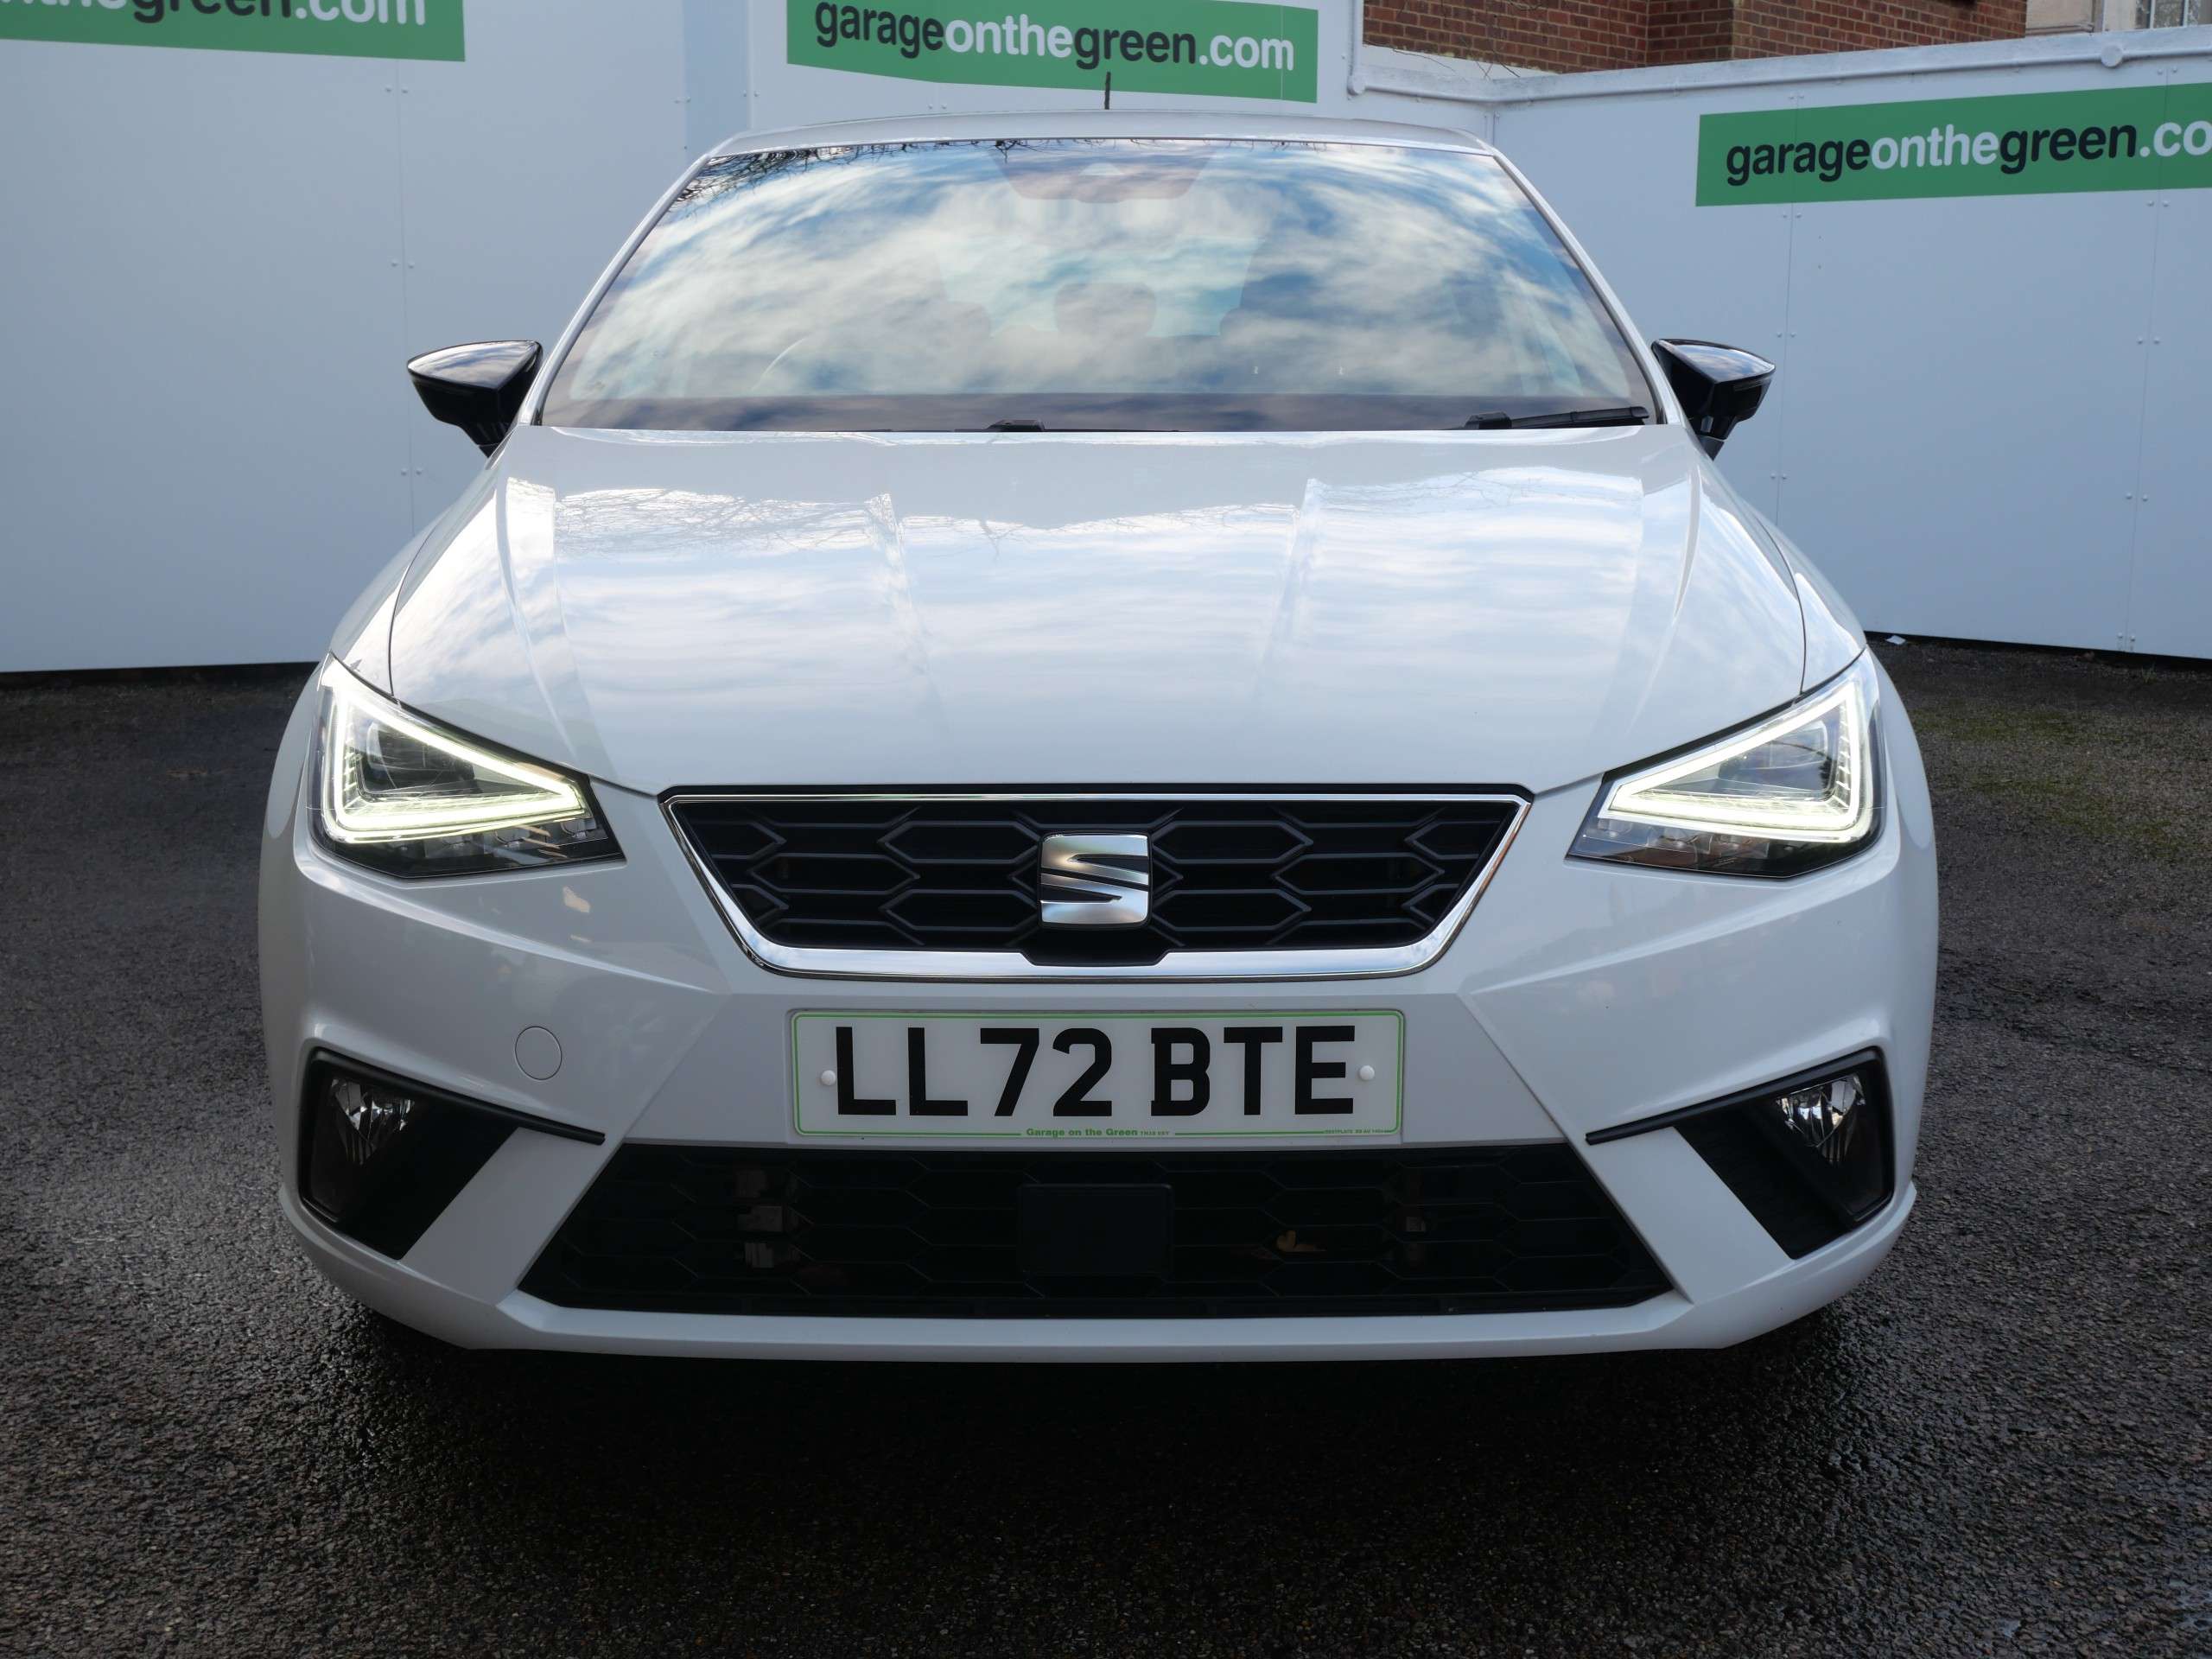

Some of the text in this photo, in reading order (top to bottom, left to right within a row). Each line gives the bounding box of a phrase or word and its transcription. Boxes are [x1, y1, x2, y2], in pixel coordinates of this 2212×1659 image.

[815, 1, 1294, 71] garageonthegreen.com
[836, 1025, 1356, 1117] LL72 BTE
[1026, 1128, 1065, 1138] Garage
[1084, 1128, 1103, 1136] the
[1105, 1128, 1139, 1136] Green
